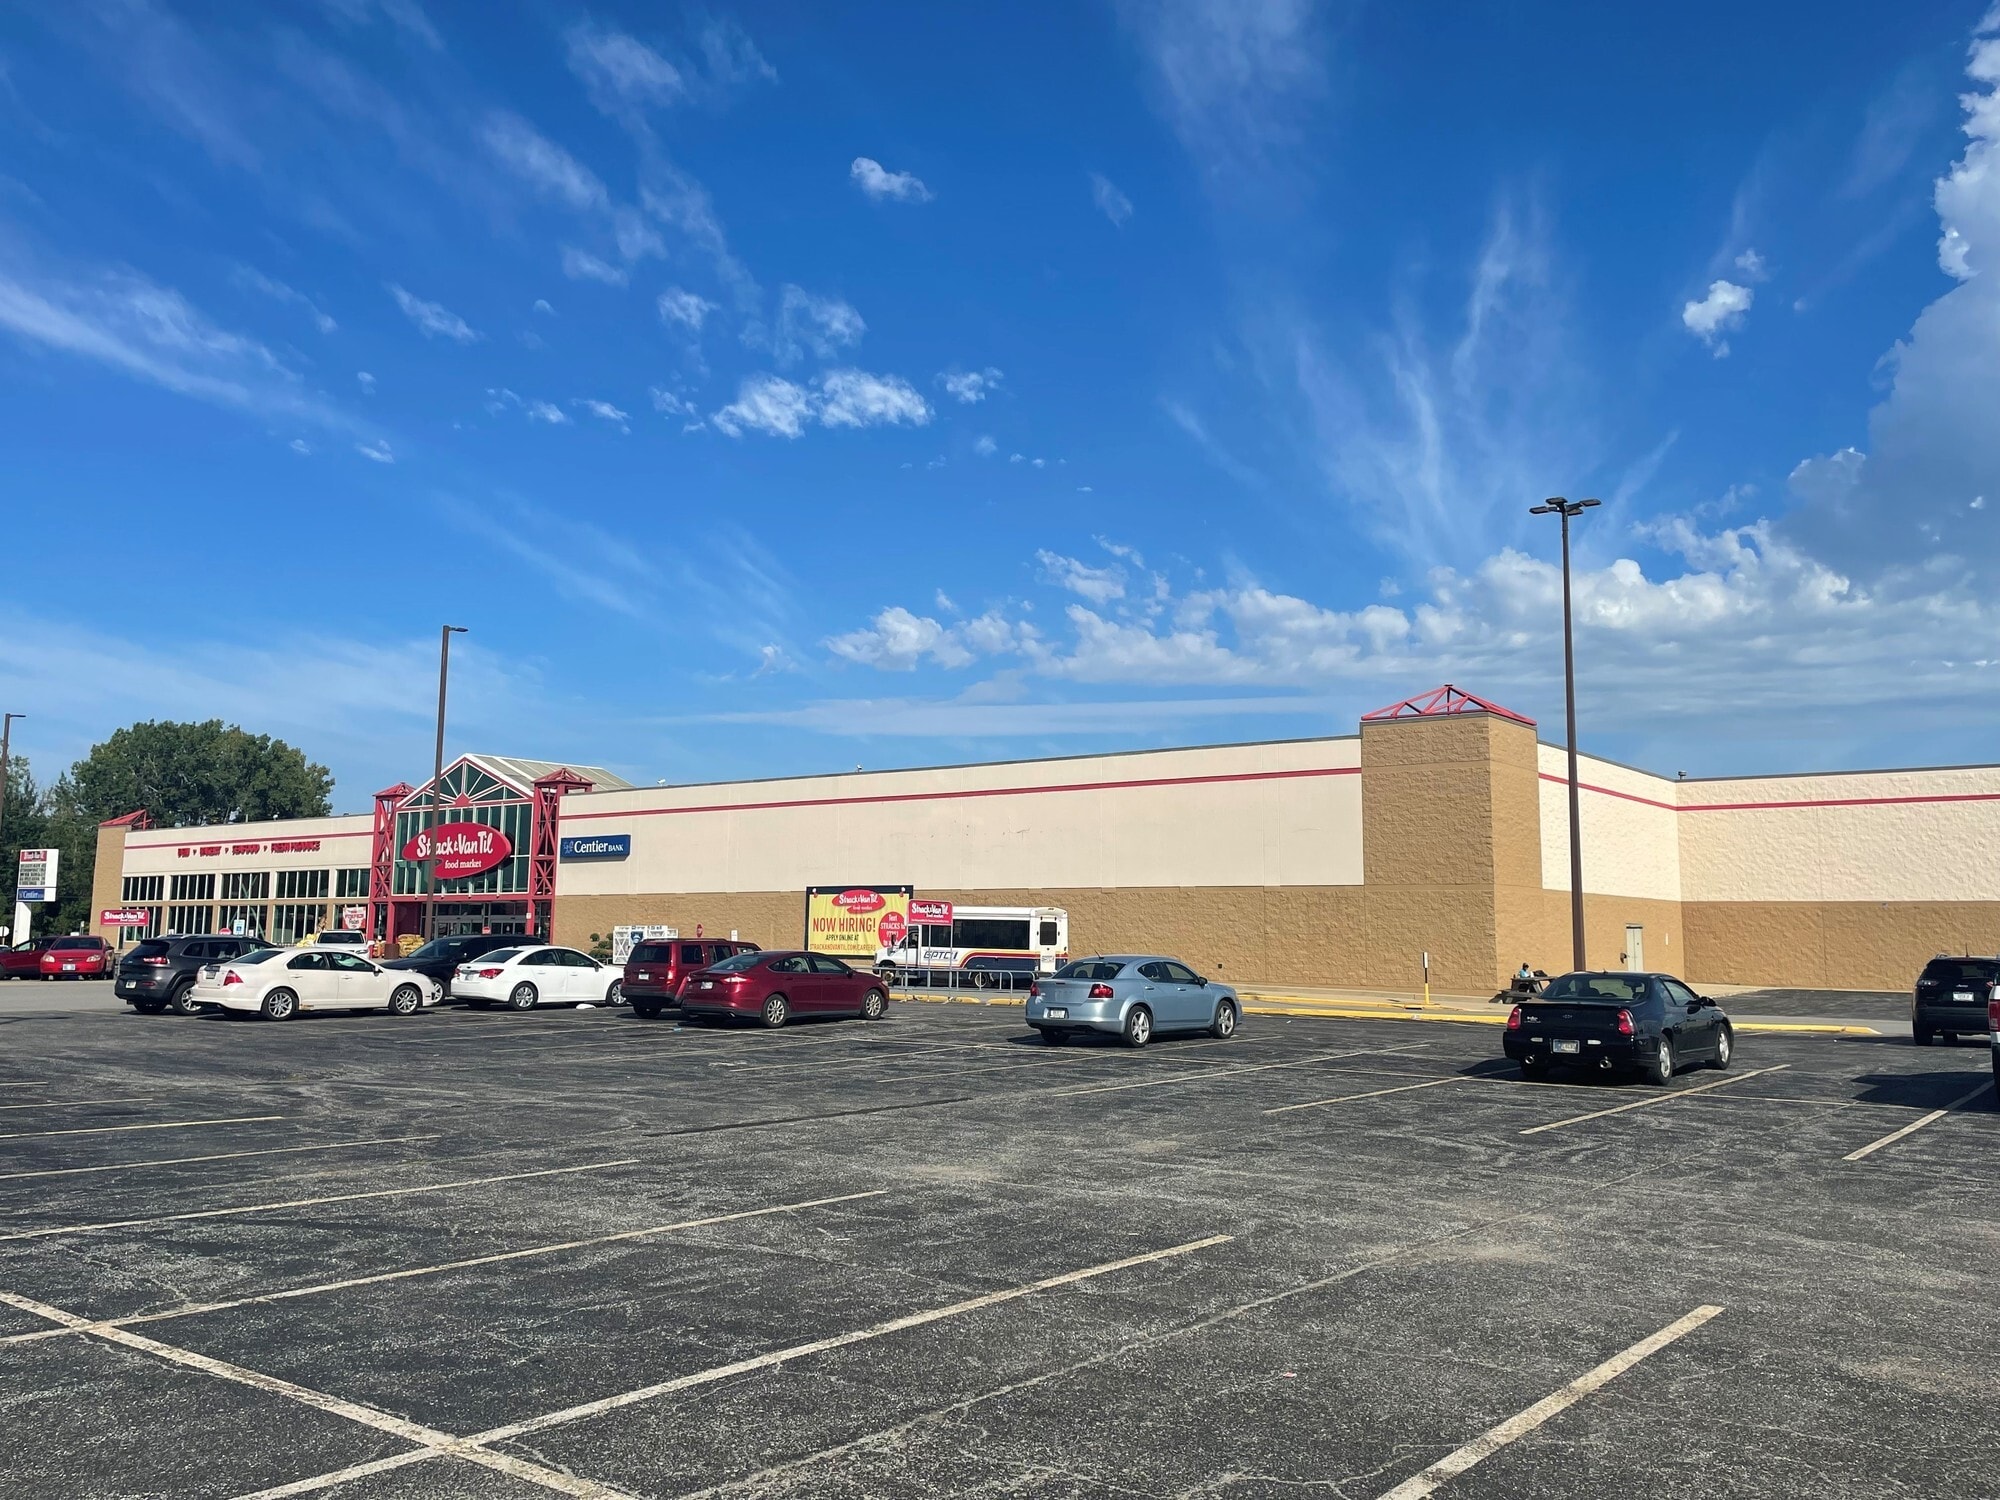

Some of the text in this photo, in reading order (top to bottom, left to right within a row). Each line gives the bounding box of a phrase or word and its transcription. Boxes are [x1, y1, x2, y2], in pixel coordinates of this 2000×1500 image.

[416, 834, 454, 857] Stack
[458, 833, 478, 855] Van
[478, 831, 493, 854] Til
[574, 840, 624, 853] Centier BANK
[445, 859, 481, 869] food market
[813, 917, 876, 932] NOW HIRING!
